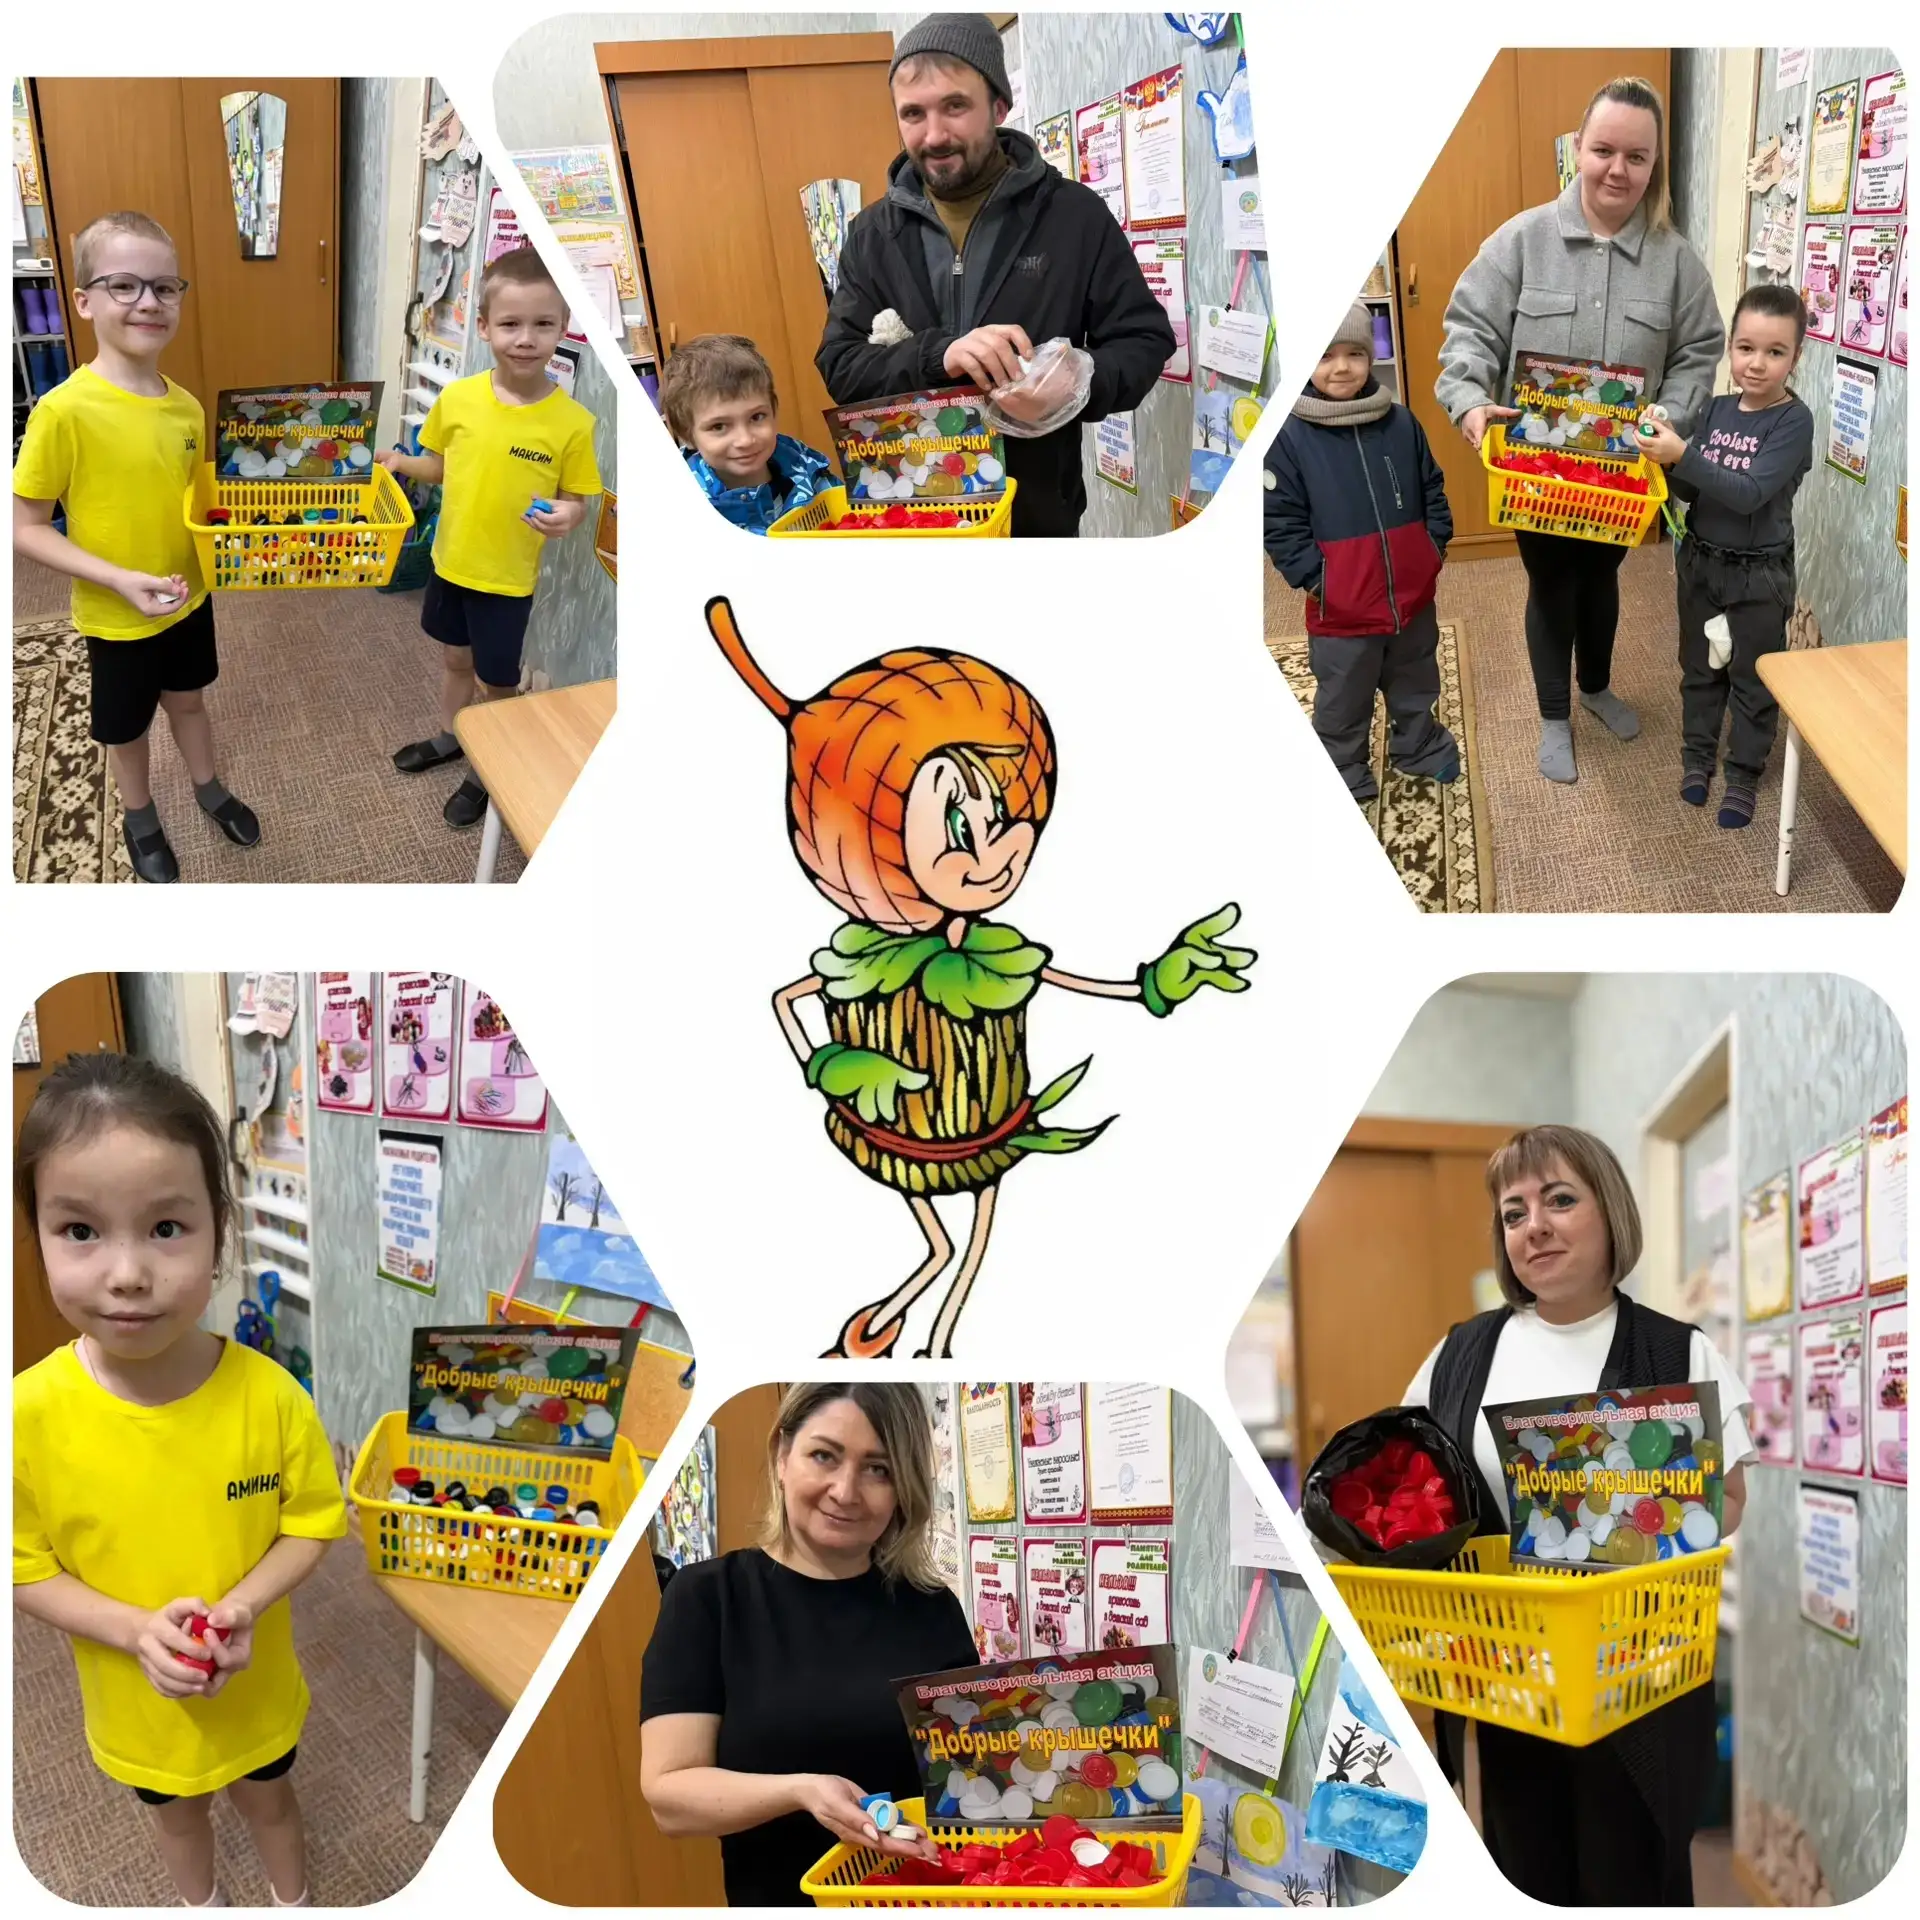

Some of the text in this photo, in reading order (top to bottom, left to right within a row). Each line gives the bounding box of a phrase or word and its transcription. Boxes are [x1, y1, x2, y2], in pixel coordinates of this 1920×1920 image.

[1514, 383, 1570, 410] "Добрые
[219, 419, 372, 441] "Добрые крышечки"
[1709, 428, 1758, 452] Coolest
[509, 445, 553, 465] МАКСИМ
[838, 428, 997, 462] "Добрые крышечки"
[415, 1363, 621, 1401] "Добрые крышечки"
[1502, 1402, 1700, 1430] Благотворительная акция
[227, 1472, 280, 1501] АМИНА
[1506, 1458, 1717, 1503] "Добрые крышечки"
[915, 1662, 1155, 1699] Благотворительная акция
[915, 1724, 1022, 1762] "Добрые
[1027, 1714, 1172, 1761] крышечки"
